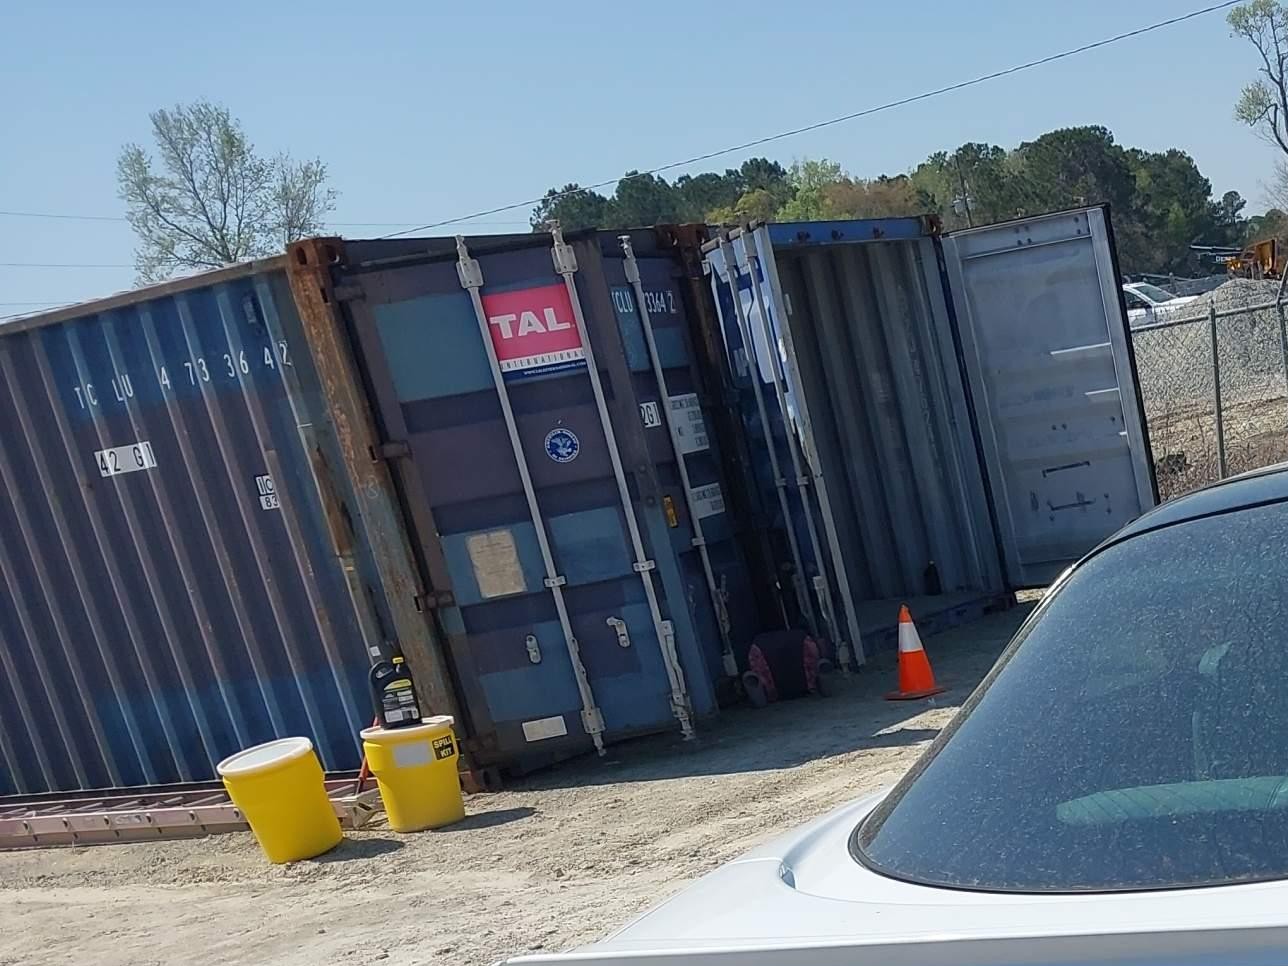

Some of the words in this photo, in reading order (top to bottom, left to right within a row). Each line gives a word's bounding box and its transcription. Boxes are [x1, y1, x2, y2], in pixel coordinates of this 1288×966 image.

[489, 308, 570, 339] TAL
[639, 404, 660, 426] 2G1
[433, 736, 452, 749] SPILL
[440, 747, 453, 758] KIT
